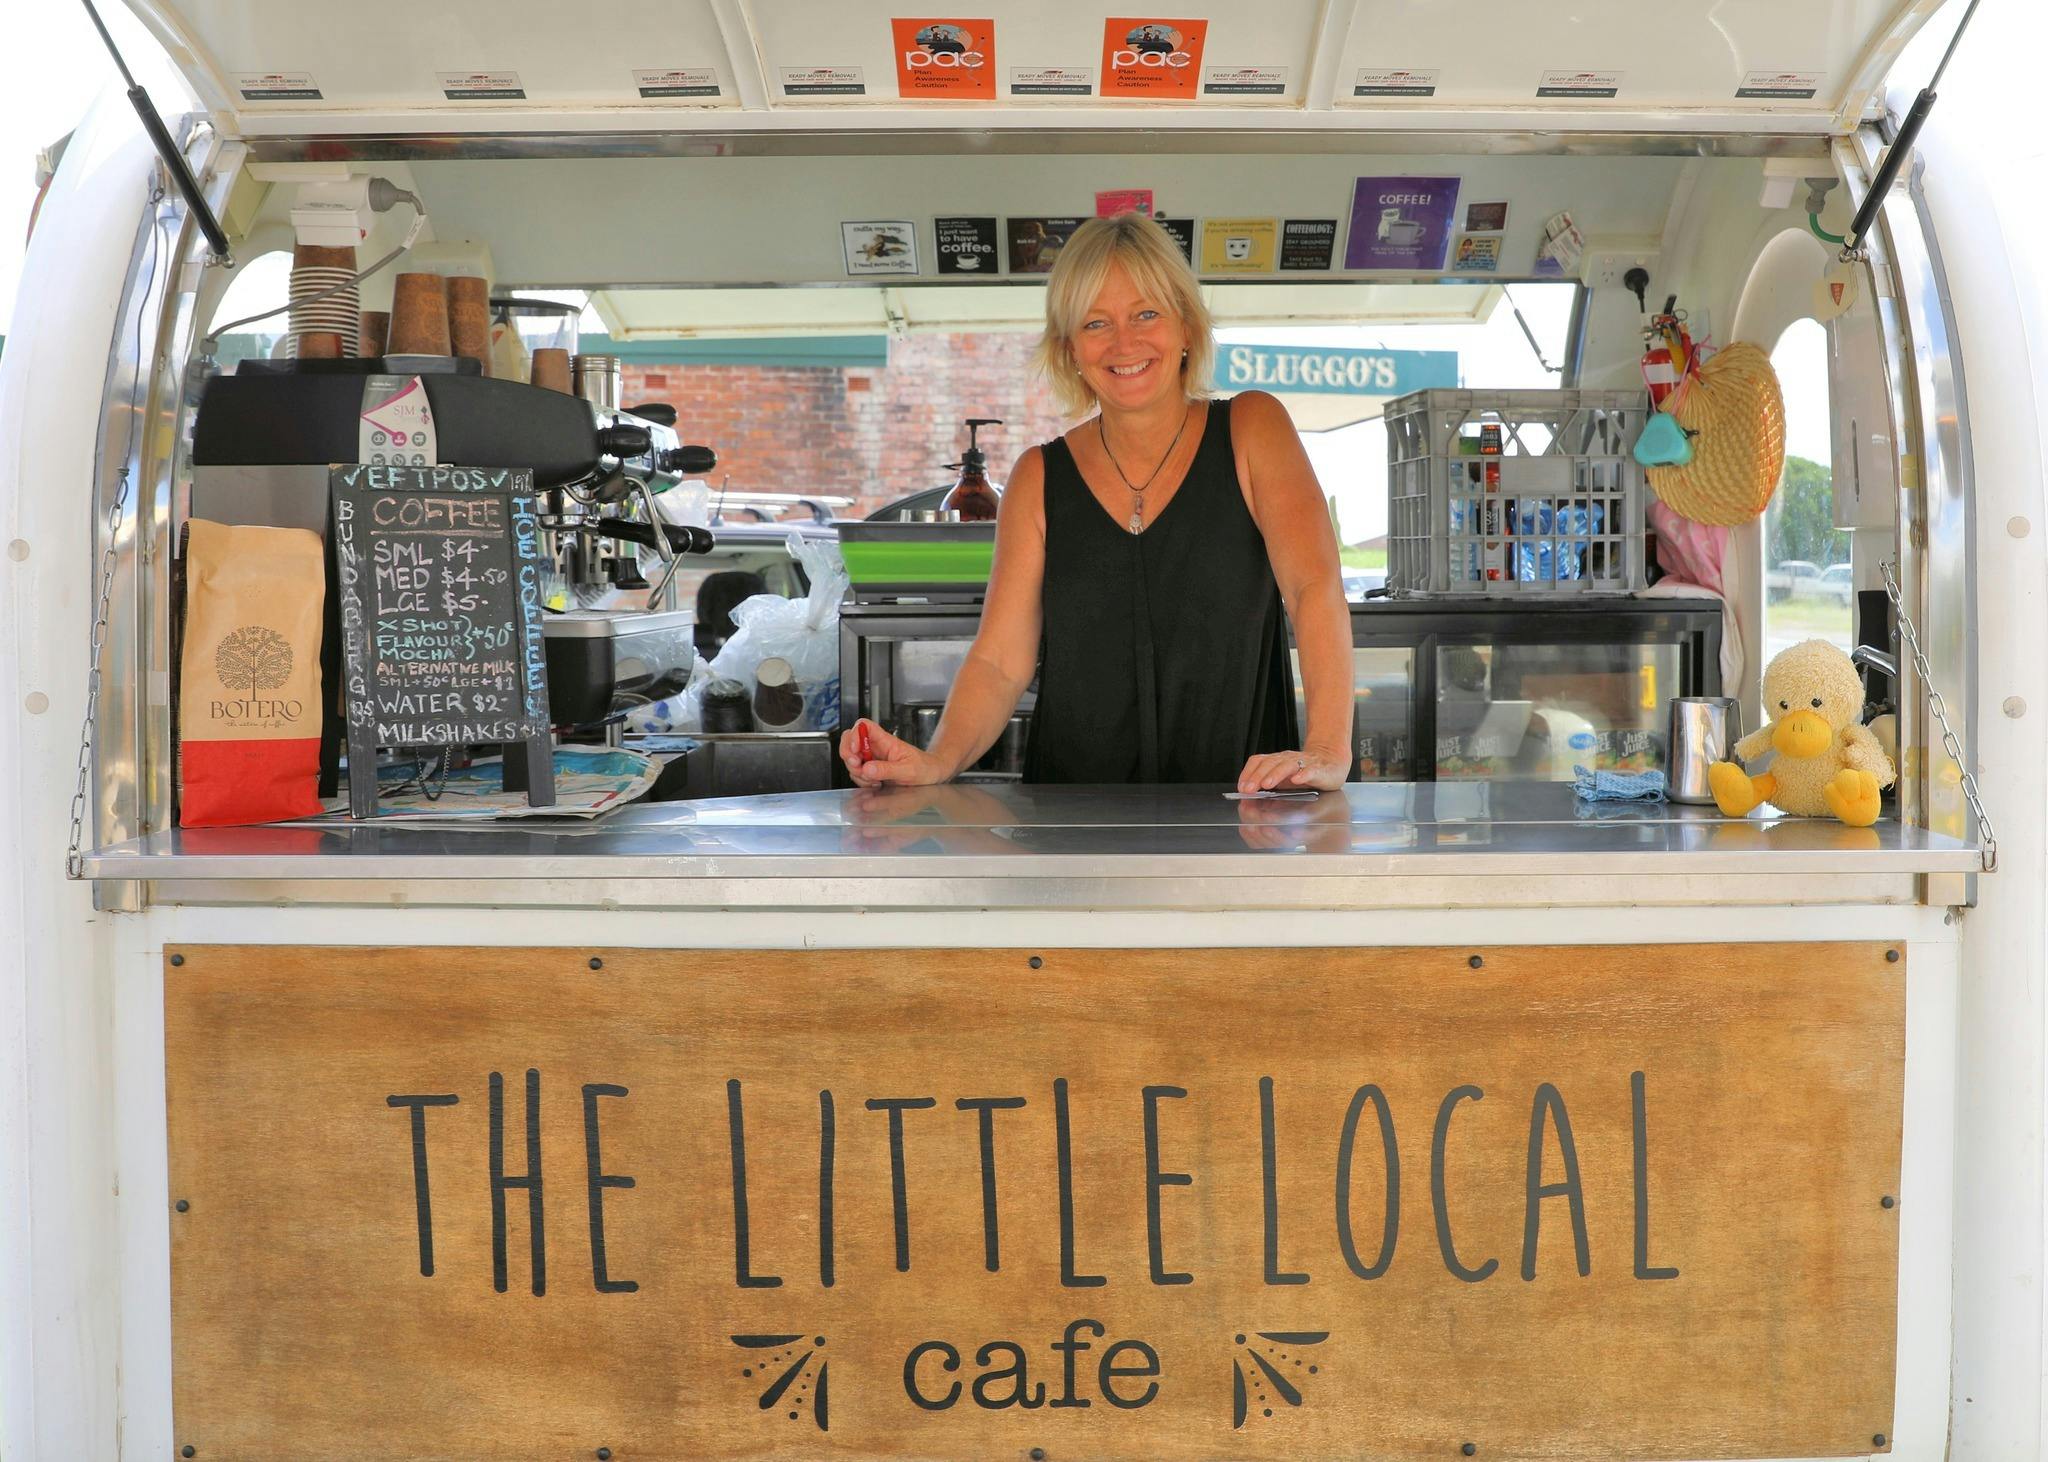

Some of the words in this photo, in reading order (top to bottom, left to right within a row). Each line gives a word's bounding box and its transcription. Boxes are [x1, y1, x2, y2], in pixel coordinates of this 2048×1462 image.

[905, 50, 984, 70] pac
[1112, 50, 1191, 70] pac
[1379, 194, 1432, 206] COFFEE!
[941, 242, 995, 253] coffee.
[953, 234, 979, 242] have
[1229, 347, 1398, 388] SLUGGO'S
[368, 466, 488, 492] EFTPOS
[372, 496, 501, 528] COFFEE
[374, 539, 433, 566] SML
[376, 565, 430, 592] MED
[378, 592, 430, 616] LGE
[376, 635, 462, 648] FLAVOUR
[379, 649, 456, 661] MOCHA
[376, 663, 479, 676] ALTERNATIVE
[482, 660, 516, 675] MILK
[211, 699, 303, 722] BOTERO
[377, 691, 467, 715] WATER
[378, 722, 517, 744] MILKSHAKES
[1625, 730, 1649, 744] JUST
[1621, 740, 1651, 757] JUICE
[386, 1067, 639, 1298] THE
[727, 1077, 1194, 1289] LITTLE
[1258, 1070, 1681, 1284] LOCAL
[903, 1318, 1161, 1410] cafe
